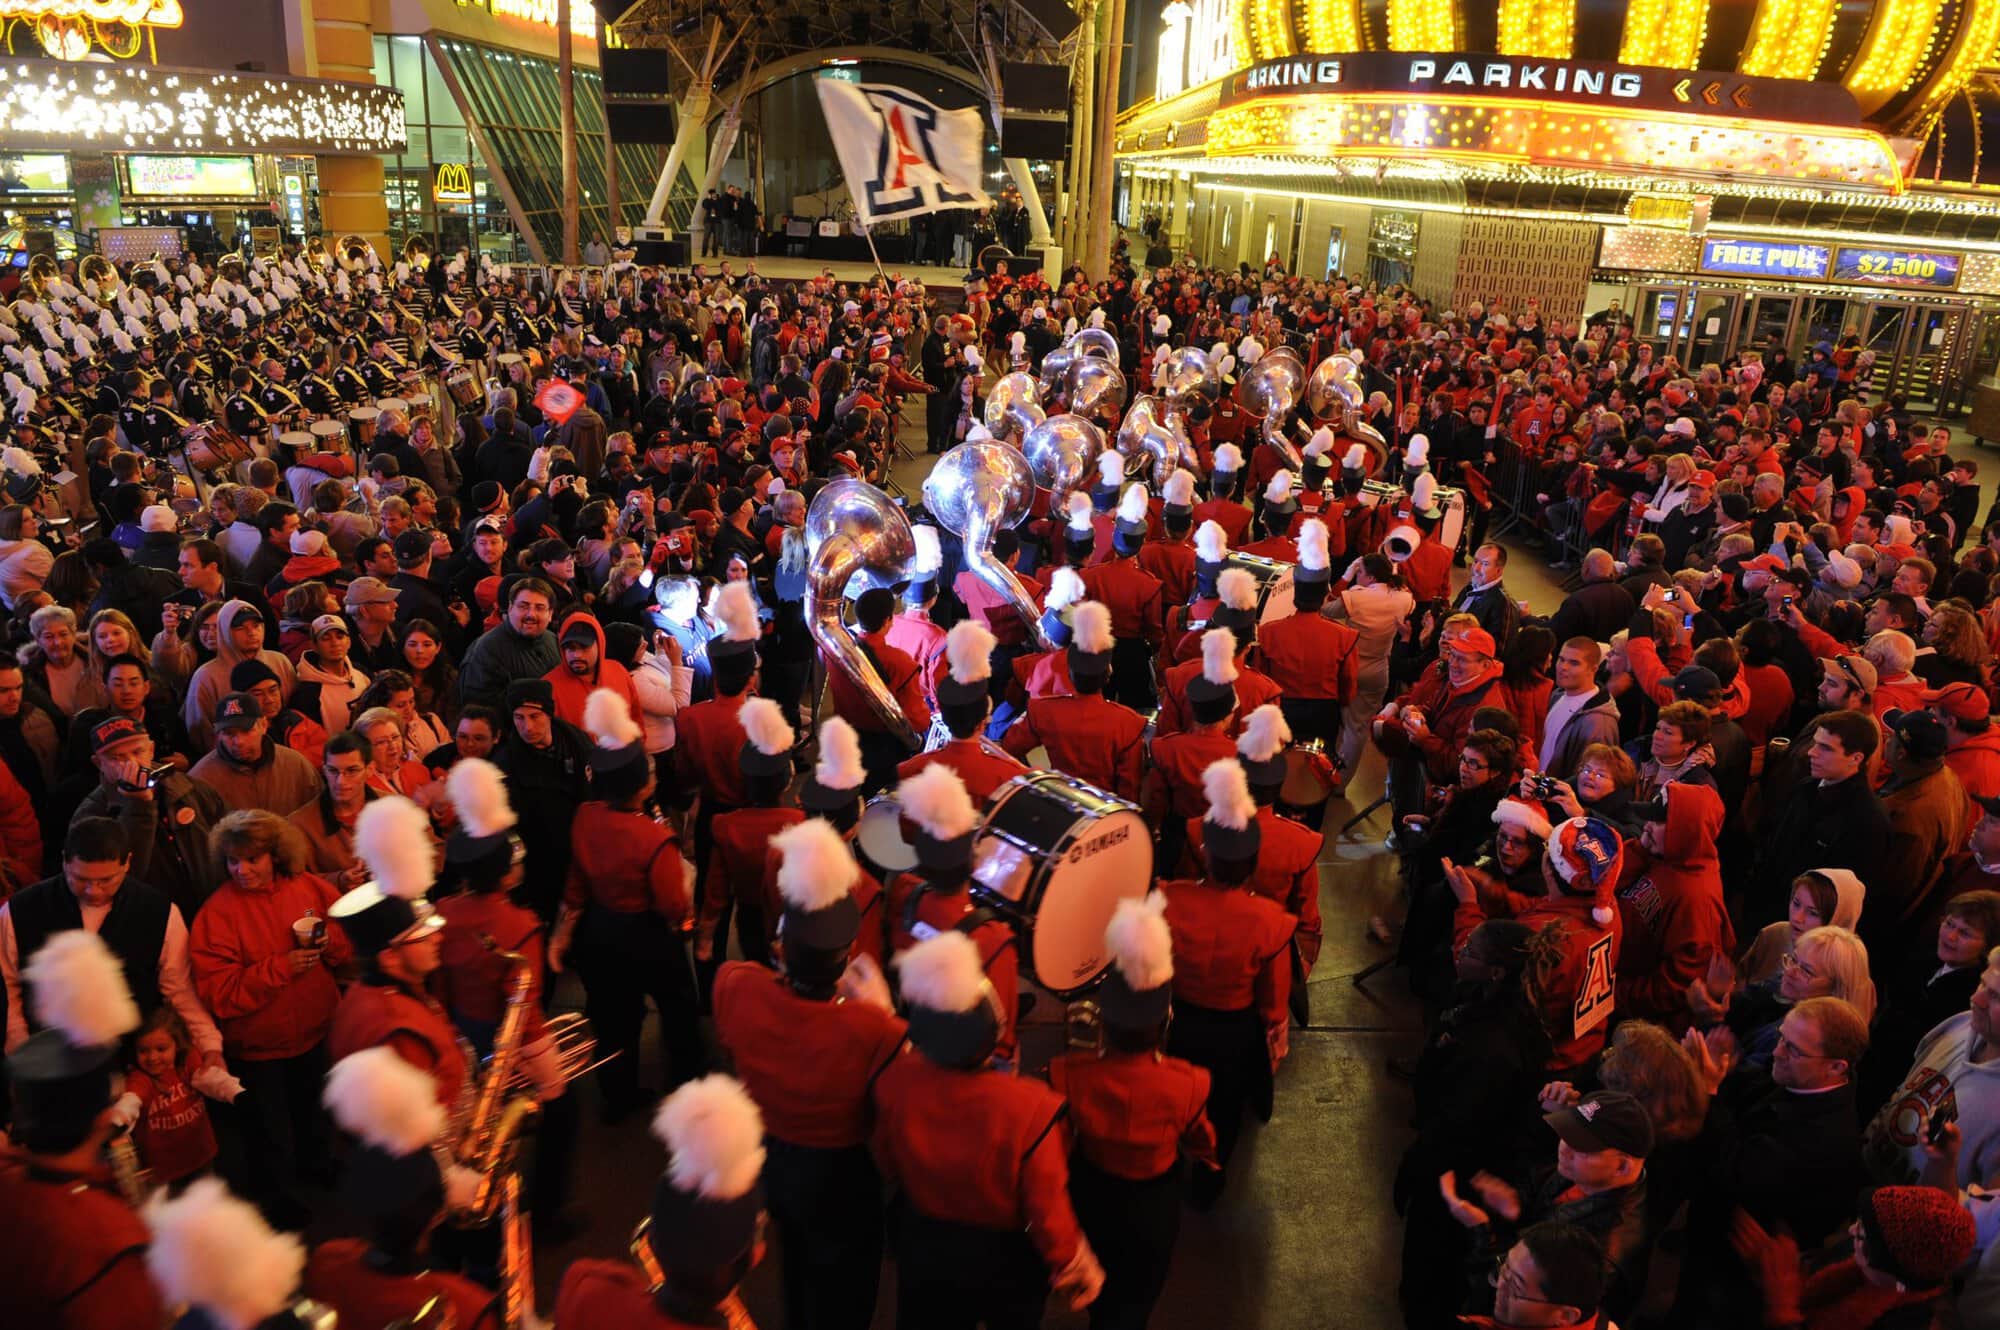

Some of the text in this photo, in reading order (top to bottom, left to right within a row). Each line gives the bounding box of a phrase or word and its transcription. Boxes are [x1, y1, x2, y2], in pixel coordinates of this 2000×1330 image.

[1247, 60, 1341, 90] PARKING
[1408, 59, 1642, 98] PARKING
[858, 86, 976, 216] A
[1711, 244, 1819, 270] FREE PULL
[223, 699, 243, 716] A
[1576, 935, 1615, 1020] A
